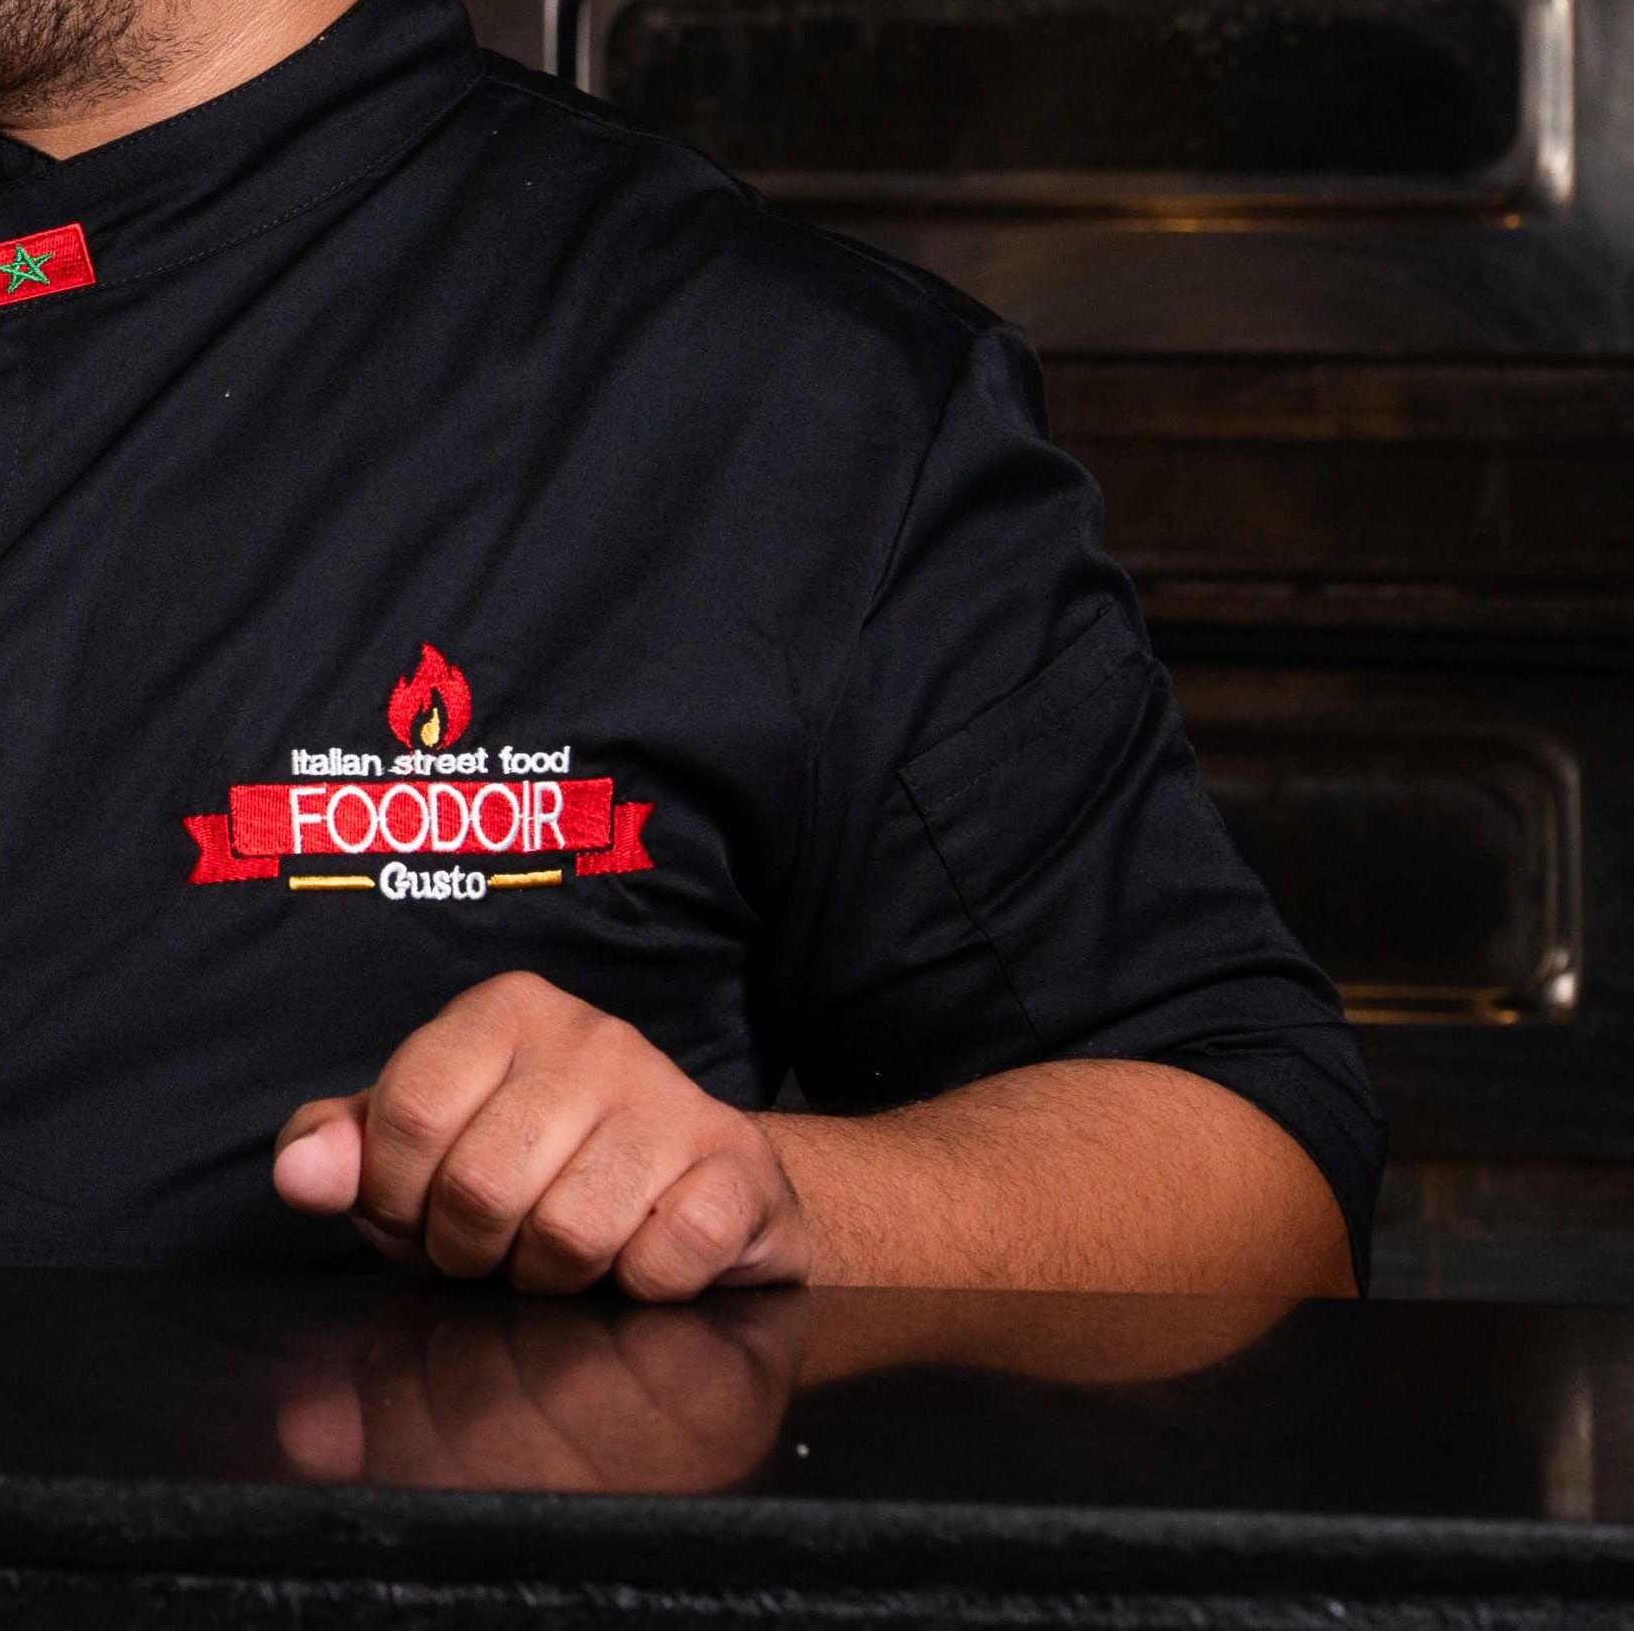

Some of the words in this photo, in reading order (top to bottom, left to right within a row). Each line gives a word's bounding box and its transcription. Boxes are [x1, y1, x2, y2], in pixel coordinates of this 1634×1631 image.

[291, 748, 382, 777] Italian
[393, 748, 488, 776] street
[497, 745, 571, 773] food
[288, 779, 566, 855] FOODOIR
[379, 861, 488, 900] Gusto
